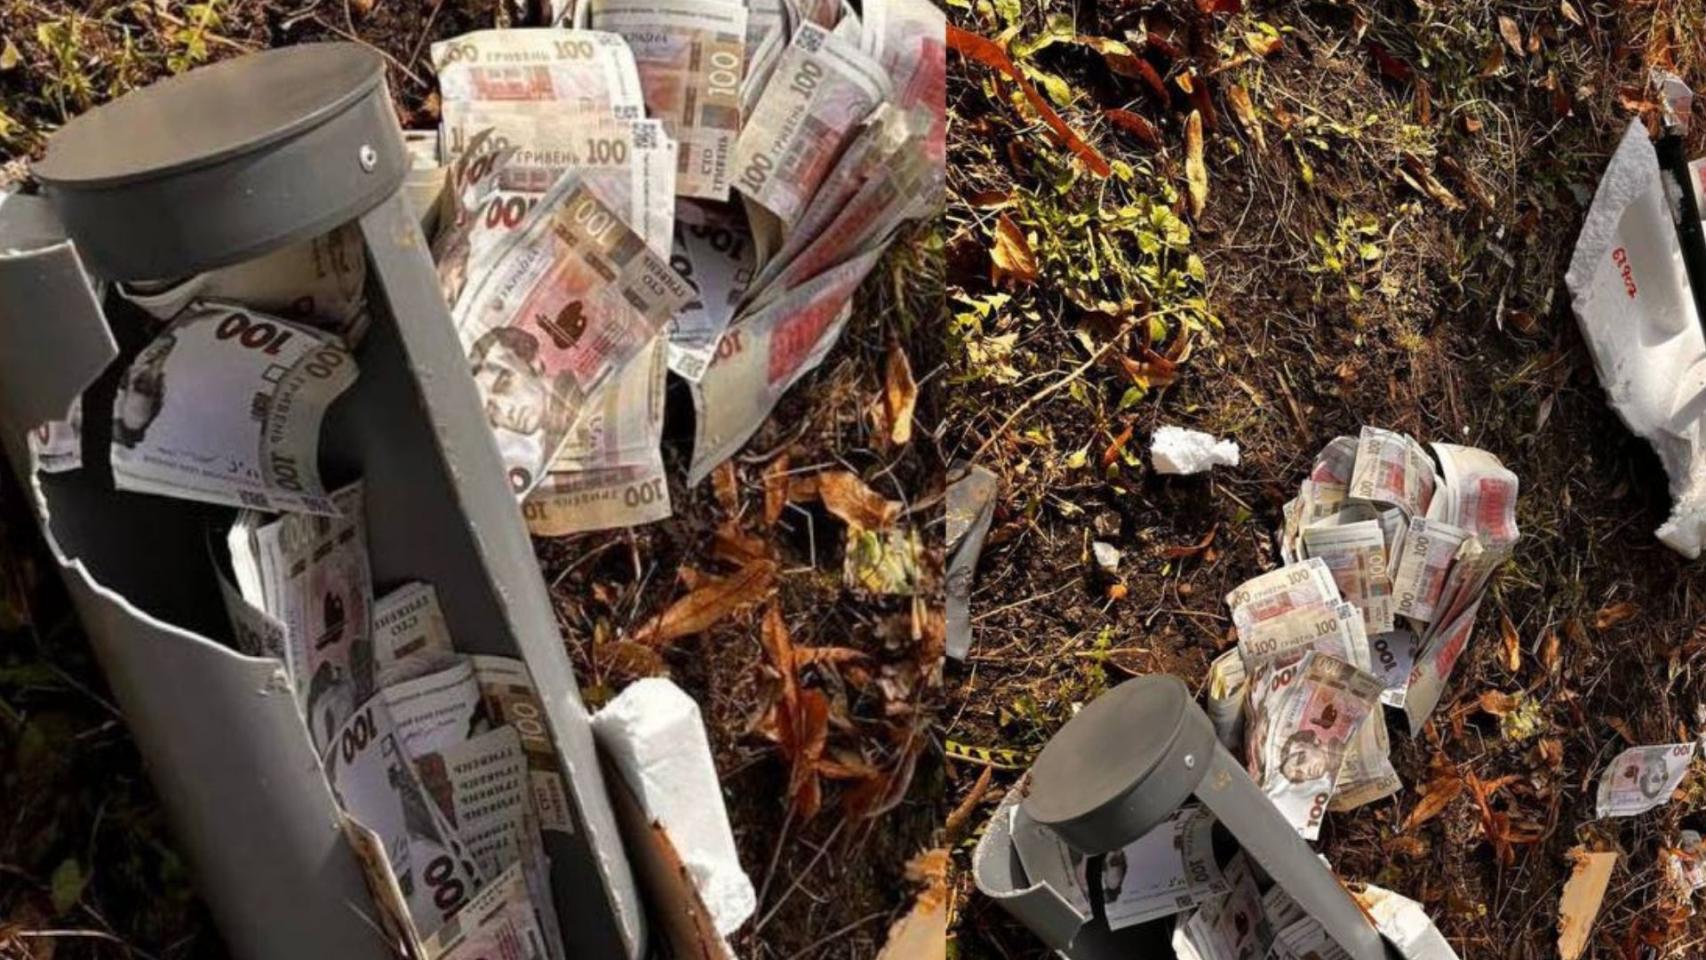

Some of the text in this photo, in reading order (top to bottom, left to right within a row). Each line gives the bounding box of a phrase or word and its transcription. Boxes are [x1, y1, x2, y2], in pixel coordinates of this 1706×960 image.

[553, 40, 593, 60] 100
[708, 52, 740, 96] 100
[739, 152, 773, 193] 100
[789, 60, 823, 99] 100
[516, 150, 580, 165] ГРИВЕНЬ
[586, 138, 626, 164] 100
[574, 198, 619, 246] 100
[215, 312, 293, 356] 100
[270, 340, 349, 491] 100 ГРИВЕНЬ 100
[623, 477, 665, 508] 100
[1286, 568, 1310, 586] 100
[1369, 554, 1384, 580] 100
[1400, 591, 1414, 614] 100
[1415, 536, 1430, 558] 100
[1254, 637, 1278, 656] 100
[1314, 618, 1338, 637] 100
[1374, 638, 1398, 673] 100
[342, 706, 378, 766] 100
[511, 701, 543, 742] 100
[1307, 792, 1329, 828] 100
[423, 854, 468, 923] 100
